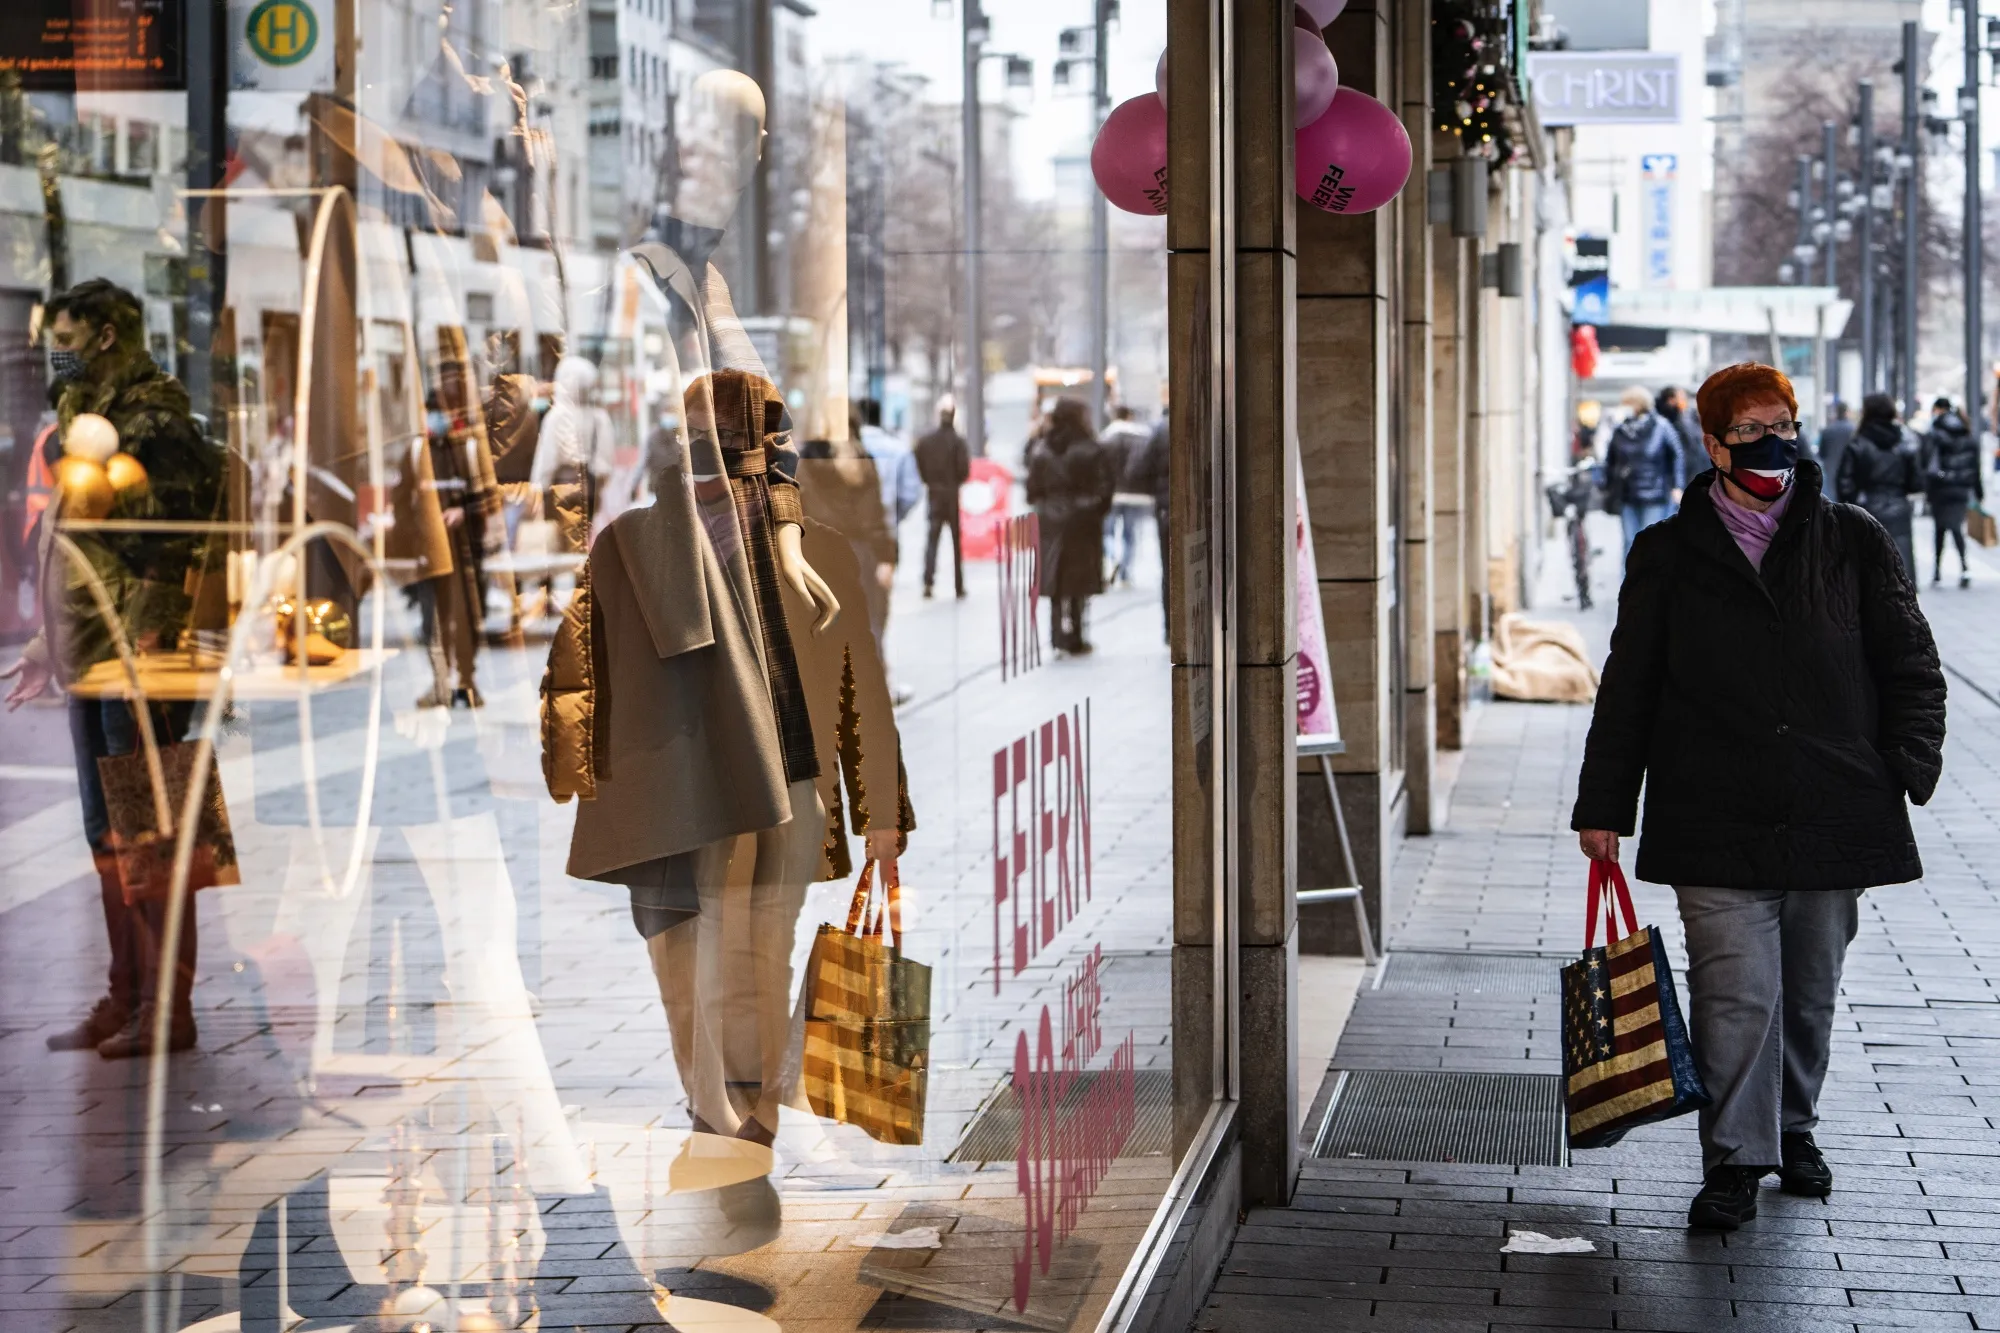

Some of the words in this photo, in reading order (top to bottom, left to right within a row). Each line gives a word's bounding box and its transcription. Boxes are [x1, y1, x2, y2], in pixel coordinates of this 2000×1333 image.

[1533, 68, 1676, 110] CHRIST
[1328, 187, 1356, 212] WIR
[996, 512, 1041, 683] WIR
[993, 696, 1091, 996] FEIERN
[1056, 941, 1101, 1098] JAHRE
